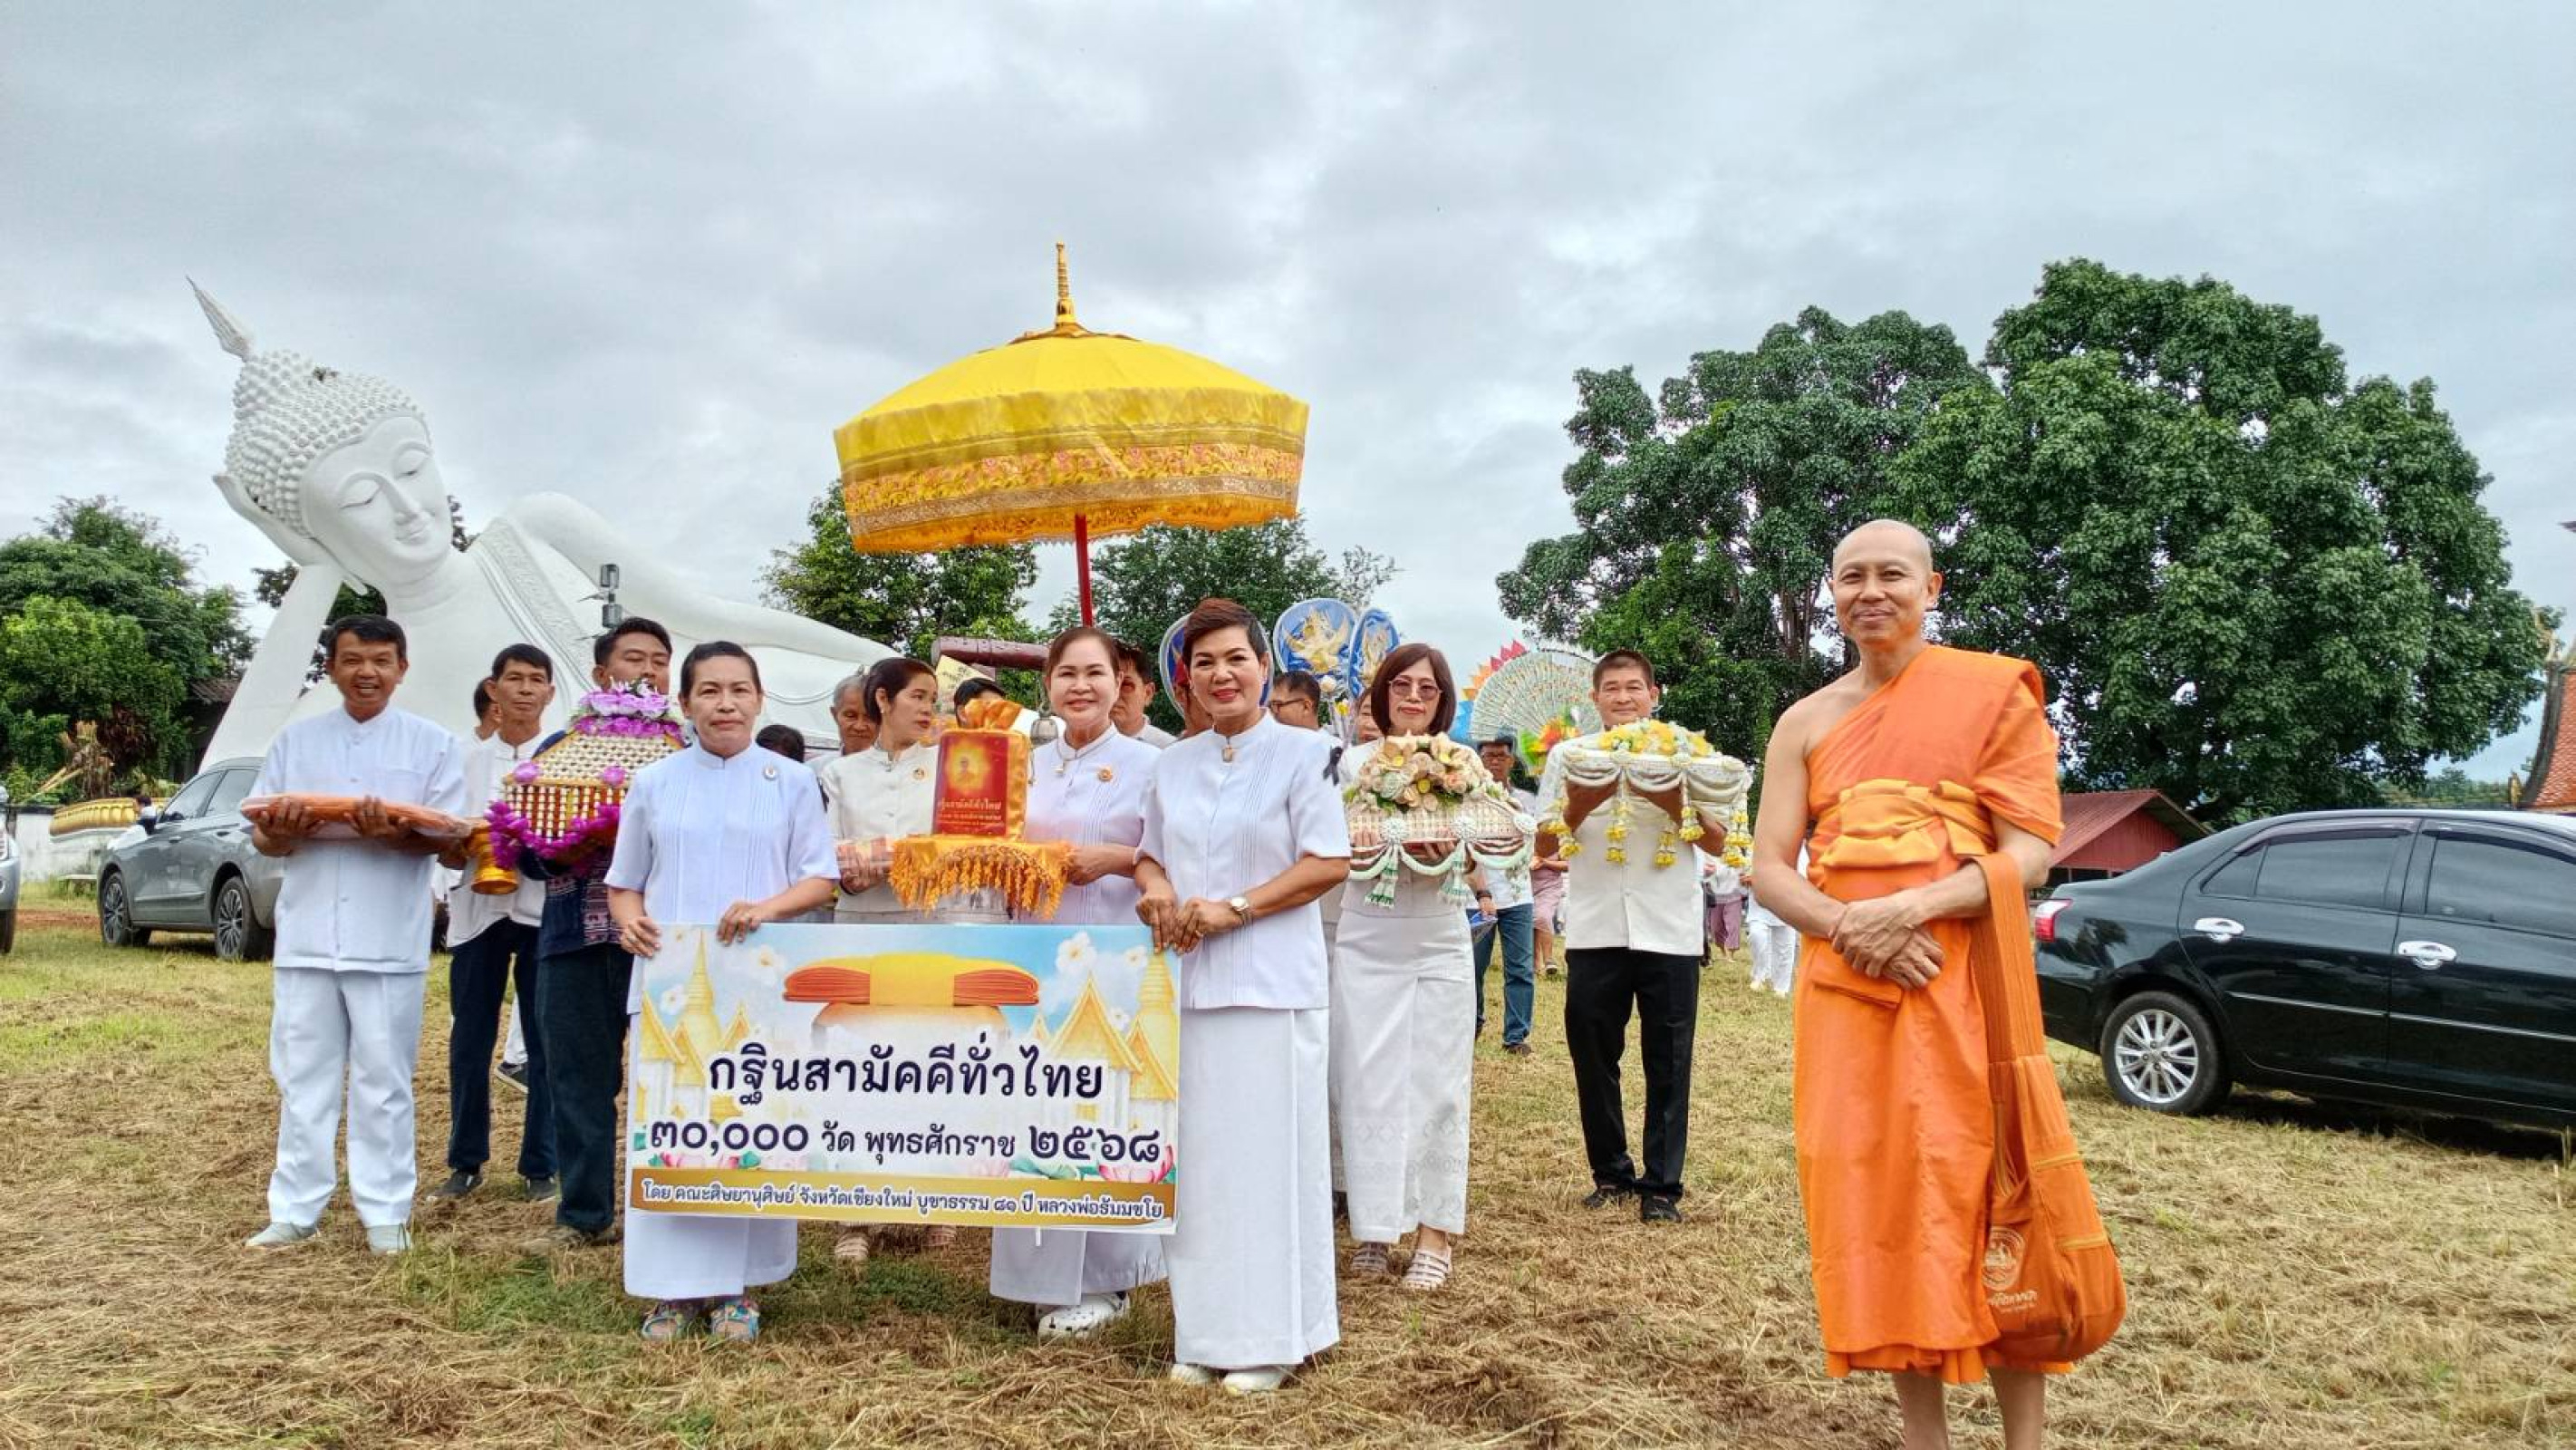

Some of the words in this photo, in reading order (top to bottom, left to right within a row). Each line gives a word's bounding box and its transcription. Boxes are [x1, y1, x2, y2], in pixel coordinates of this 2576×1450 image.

[709, 1031, 1103, 1106] กฐินสามัคคีทั่วไทย
[651, 1121, 809, 1156] ๓๐,๐๐๐
[822, 1120, 854, 1152] วัด
[865, 1123, 1016, 1165] พุทธศักราช
[1029, 1125, 1161, 1163] ๒๕๖๘
[642, 1180, 671, 1201] โดย
[675, 1182, 796, 1208] คณะศิษยานุศิษย์
[799, 1186, 913, 1208] จังหวัดเชียงใหม่
[917, 1194, 989, 1215] บูชาธรรม
[994, 1197, 1016, 1212] ๘๑
[1021, 1193, 1033, 1212] ปี
[1038, 1194, 1163, 1218] หลวงพ่อธัมมชโย
